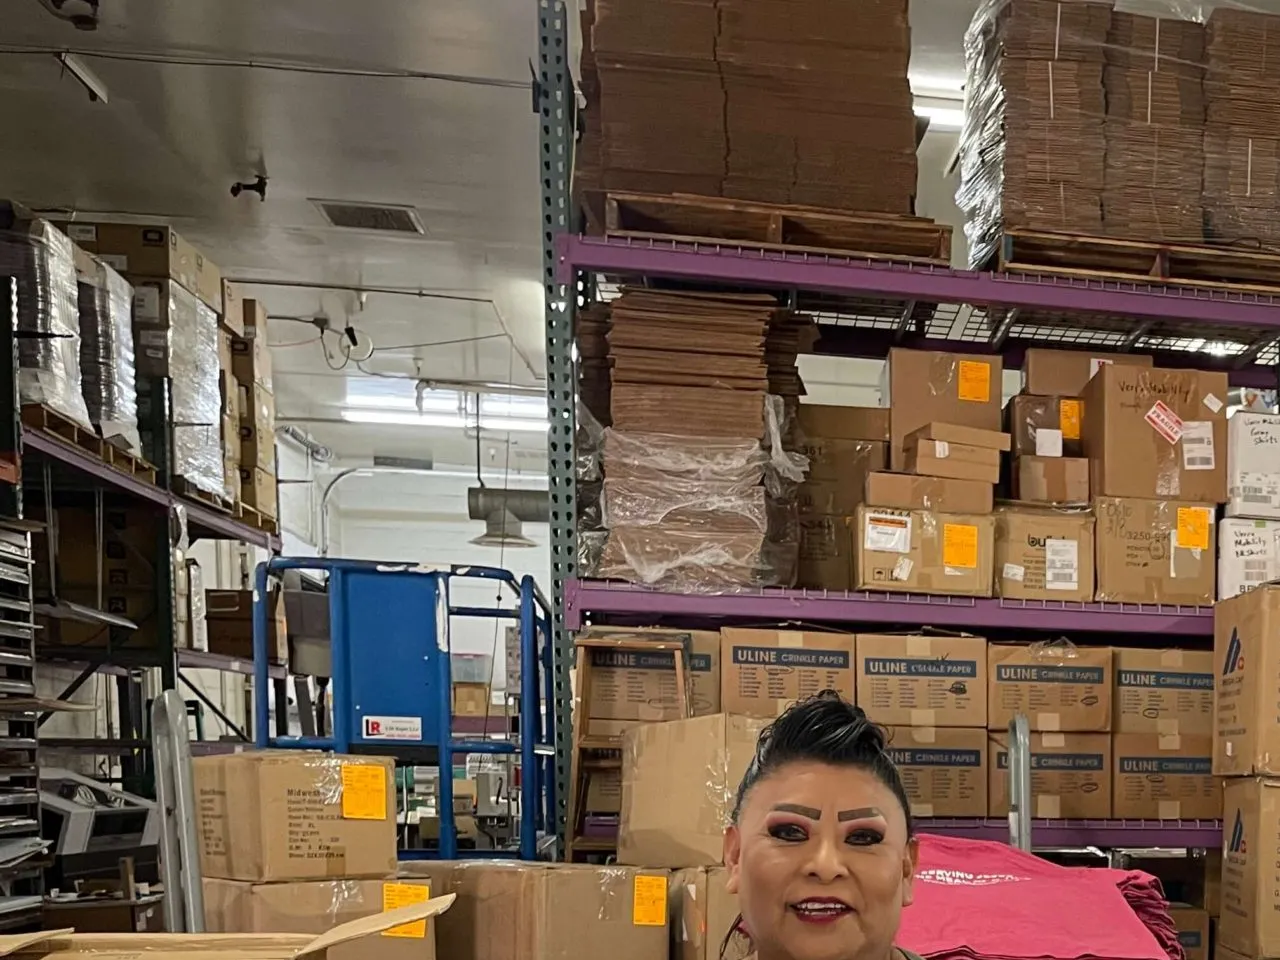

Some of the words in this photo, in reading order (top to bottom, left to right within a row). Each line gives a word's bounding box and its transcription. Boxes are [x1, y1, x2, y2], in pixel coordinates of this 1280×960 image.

[1151, 409, 1180, 437] FRAGILE
[738, 650, 776, 663] ULINE
[781, 653, 816, 663] CRINKLE
[818, 656, 844, 665] PAPER
[869, 662, 907, 673] ULINE
[947, 665, 972, 673] PAPER
[1001, 668, 1037, 679] ULINE
[1121, 673, 1156, 685] ULINE
[890, 751, 911, 763] INE
[1124, 760, 1158, 771] ULINE
